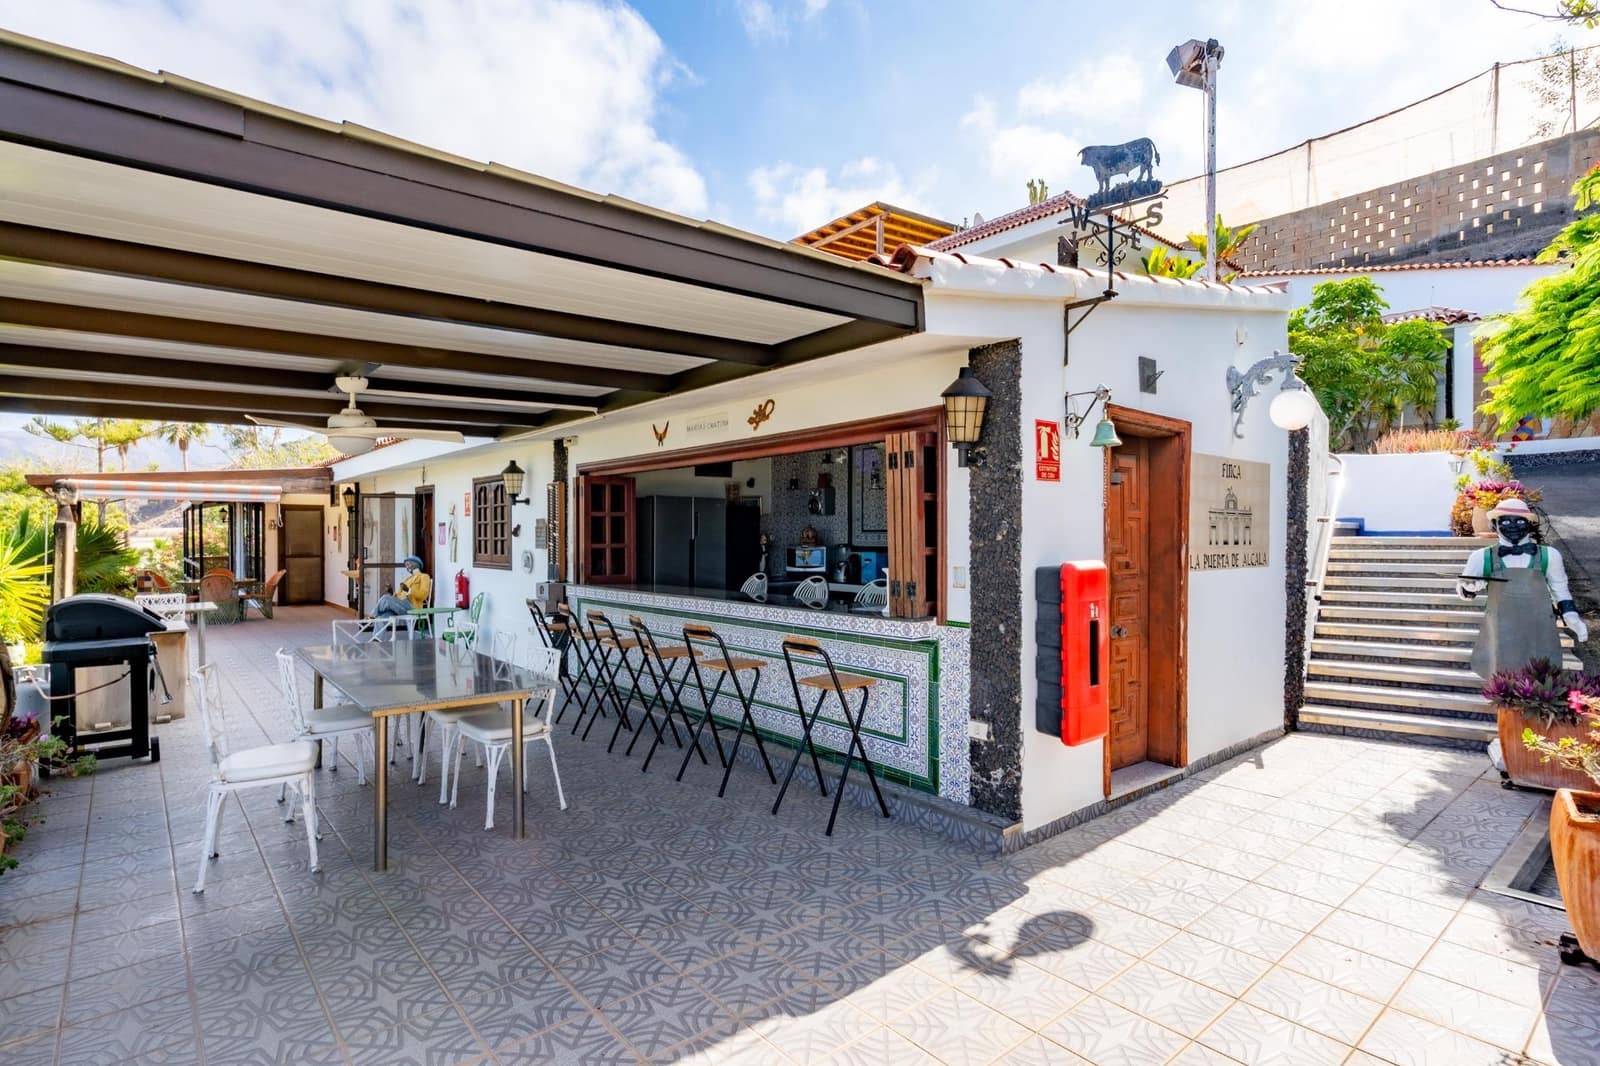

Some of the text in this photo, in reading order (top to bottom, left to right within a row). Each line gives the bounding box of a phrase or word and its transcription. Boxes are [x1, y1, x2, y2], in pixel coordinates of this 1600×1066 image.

[1070, 202, 1090, 231] W
[1146, 201, 1163, 228] S
[1130, 225, 1142, 251] E
[1221, 463, 1242, 480] FINCA
[1189, 554, 1201, 570] LA
[1203, 553, 1230, 569] PUERTA
[1231, 553, 1239, 567] DE
